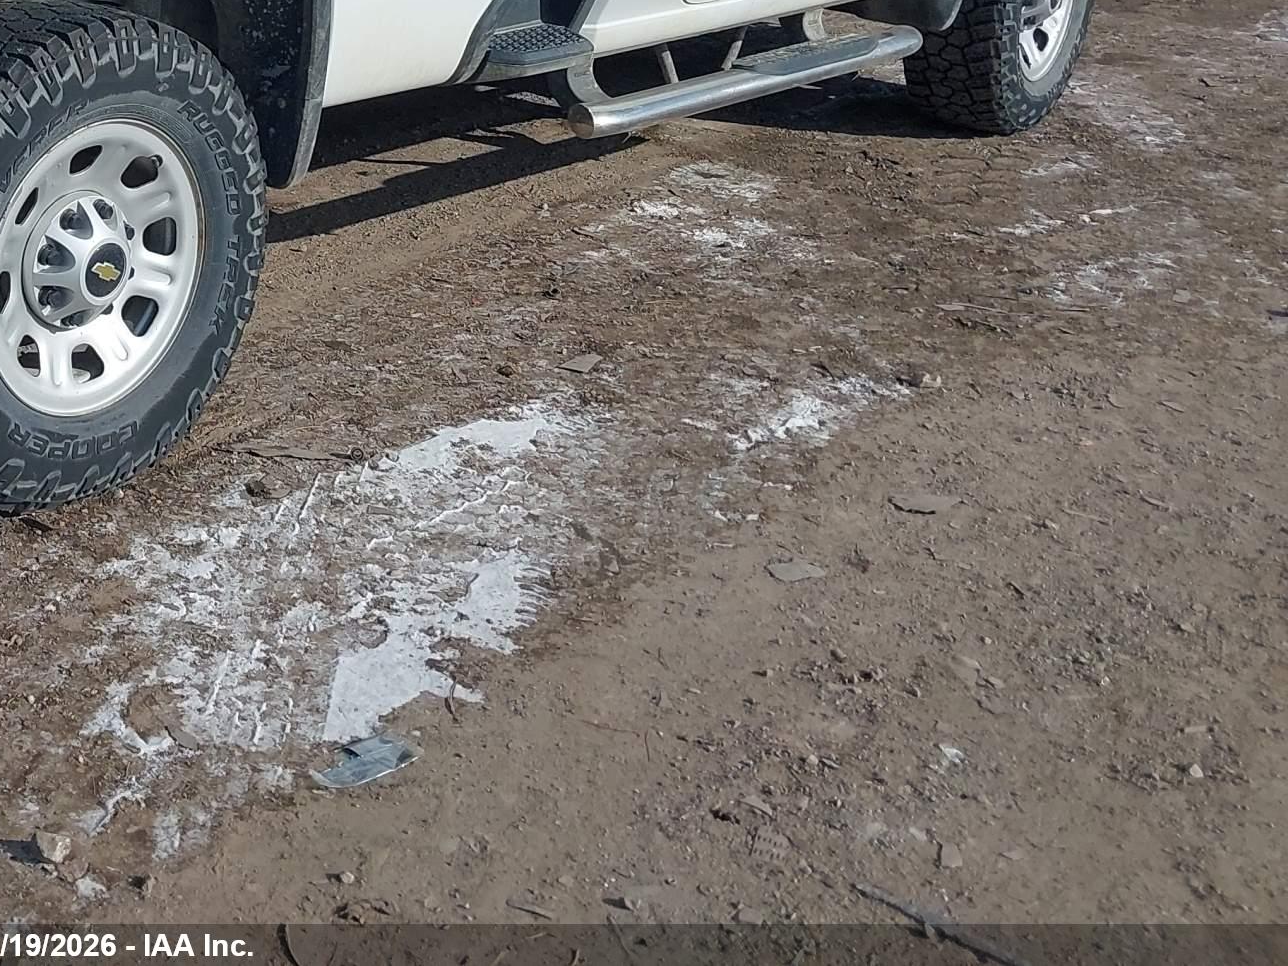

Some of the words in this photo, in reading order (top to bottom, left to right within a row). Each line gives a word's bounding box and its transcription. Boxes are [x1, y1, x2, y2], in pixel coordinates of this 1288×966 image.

[176, 99, 243, 216] RUGGED
[209, 234, 243, 337] TREK
[7, 420, 140, 460] COOPER
